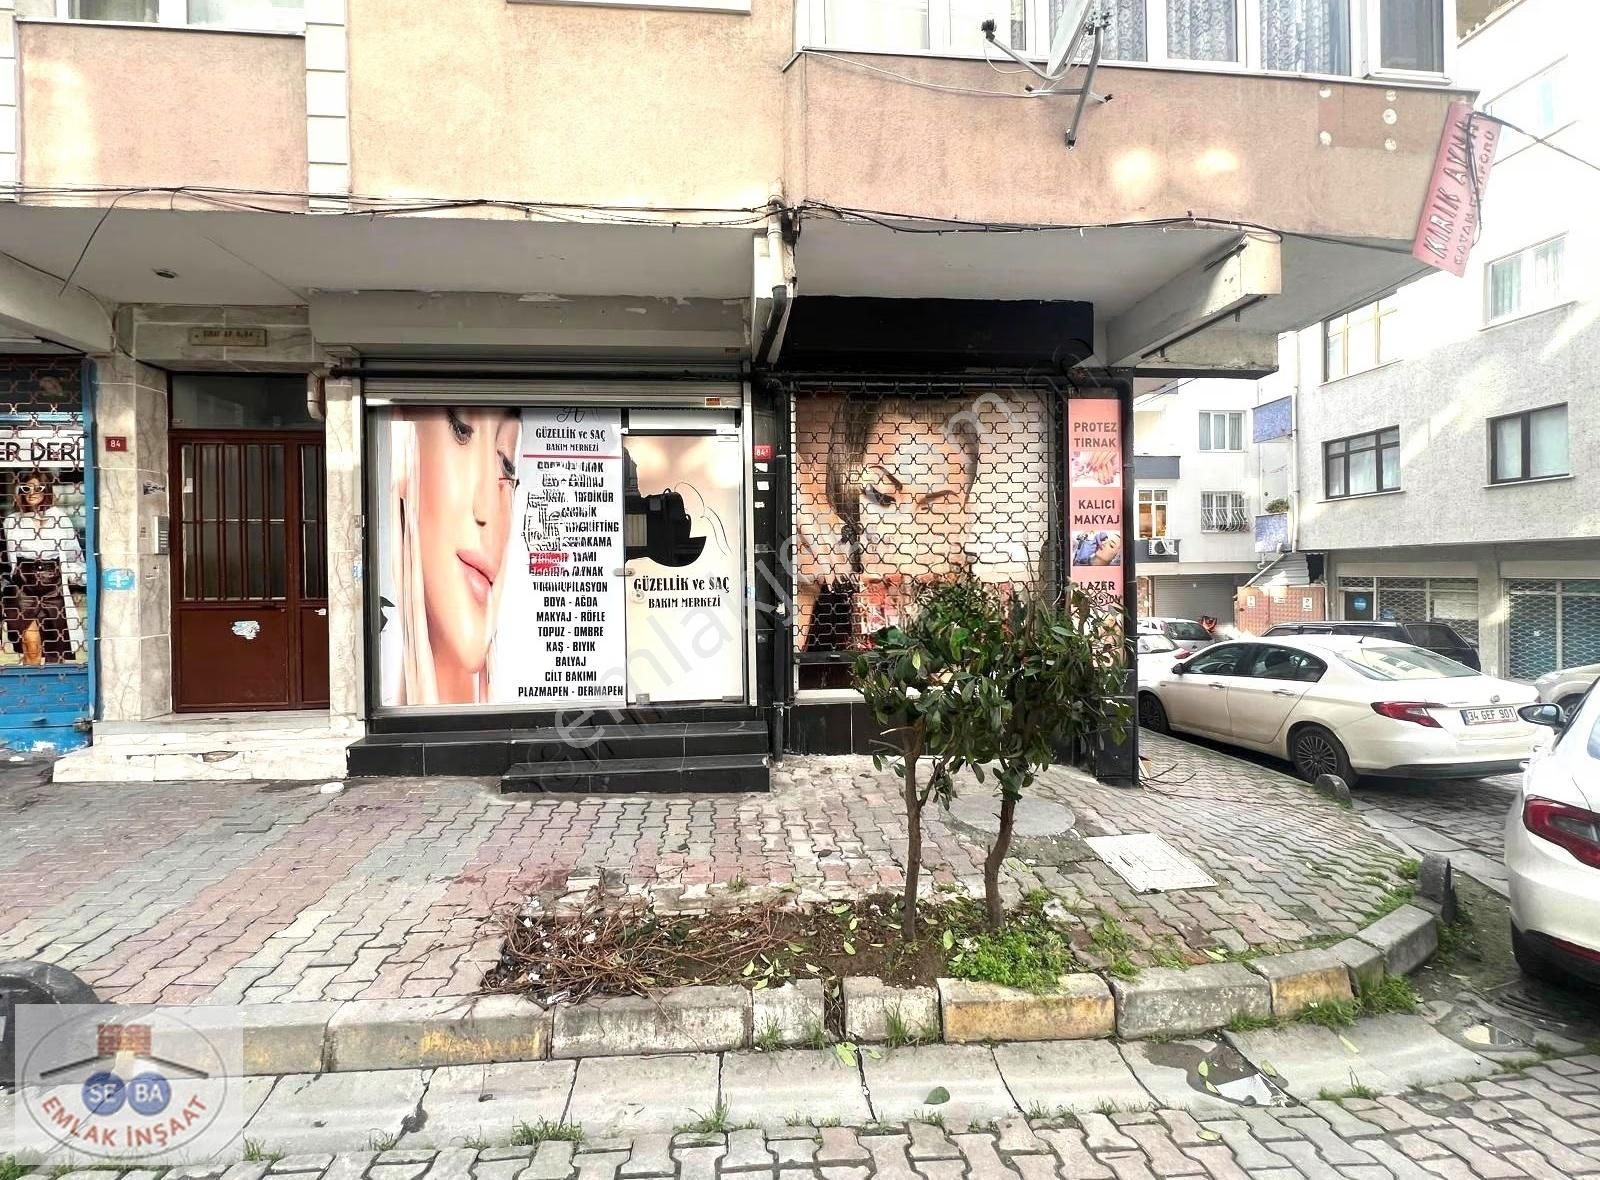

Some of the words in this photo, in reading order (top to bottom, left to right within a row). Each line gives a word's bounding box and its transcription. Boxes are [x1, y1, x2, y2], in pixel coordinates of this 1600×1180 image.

[1423, 187, 1463, 260] KIRIK
[535, 426, 576, 440] GÜZELLİK
[578, 431, 588, 440] ve
[590, 429, 606, 441] SAÇ
[1073, 422, 1117, 433] PROTEZ
[110, 439, 121, 448] 84
[546, 443, 568, 451] BAKIM
[569, 442, 599, 452] MERKEZİ
[1074, 438, 1116, 448] TIRNAK
[1079, 500, 1115, 509] KALICI
[1074, 515, 1120, 525] MAKYAJ
[634, 575, 688, 591] GÜZELLİK
[693, 579, 705, 590] ve
[709, 576, 729, 593] SAÇ
[543, 596, 566, 607] BOYA
[575, 595, 598, 607] AĞDA
[648, 598, 678, 608] BAKIM
[681, 595, 721, 608] MERKEZİ
[536, 611, 572, 622] MAKYAJ
[580, 609, 606, 622] RÖFLE
[538, 626, 565, 637] TOPUZ
[574, 626, 604, 637] OMBRE
[546, 641, 564, 654] KAŞ
[572, 641, 596, 652] BIYIK
[555, 656, 587, 667] BALYAJ
[545, 669, 562, 682] CİLT
[565, 671, 597, 682] BAKIMI
[518, 686, 569, 697] PLAZMAPEN
[577, 685, 624, 697] DERMAPEN
[1468, 711, 1479, 721] 34
[1481, 709, 1495, 720] GEF
